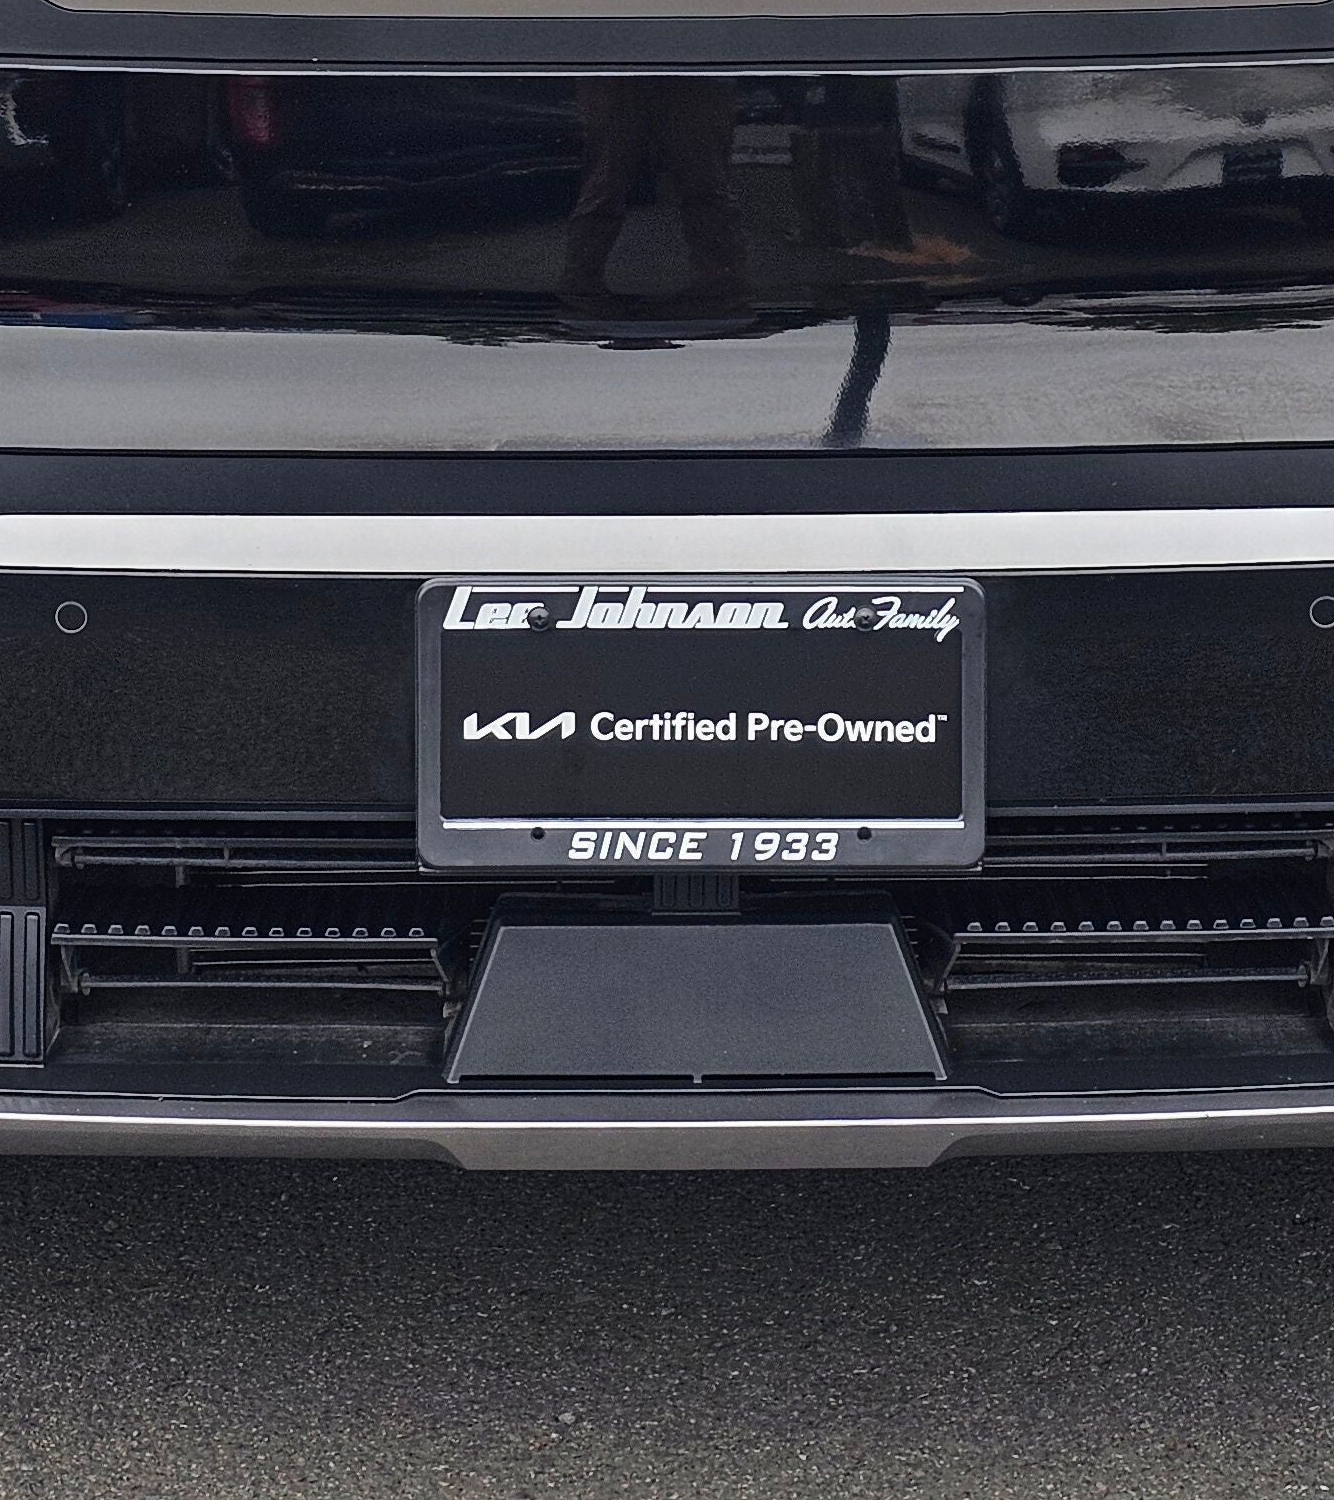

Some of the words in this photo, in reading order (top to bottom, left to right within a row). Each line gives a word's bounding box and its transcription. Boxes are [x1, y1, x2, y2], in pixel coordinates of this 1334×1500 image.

[555, 586, 789, 629] Johnson
[802, 596, 858, 630] Aut
[871, 595, 960, 642] Family
[463, 711, 576, 740] KIA
[590, 711, 737, 741] Certified
[568, 831, 708, 860] SINCE
[730, 831, 839, 861] 1933
